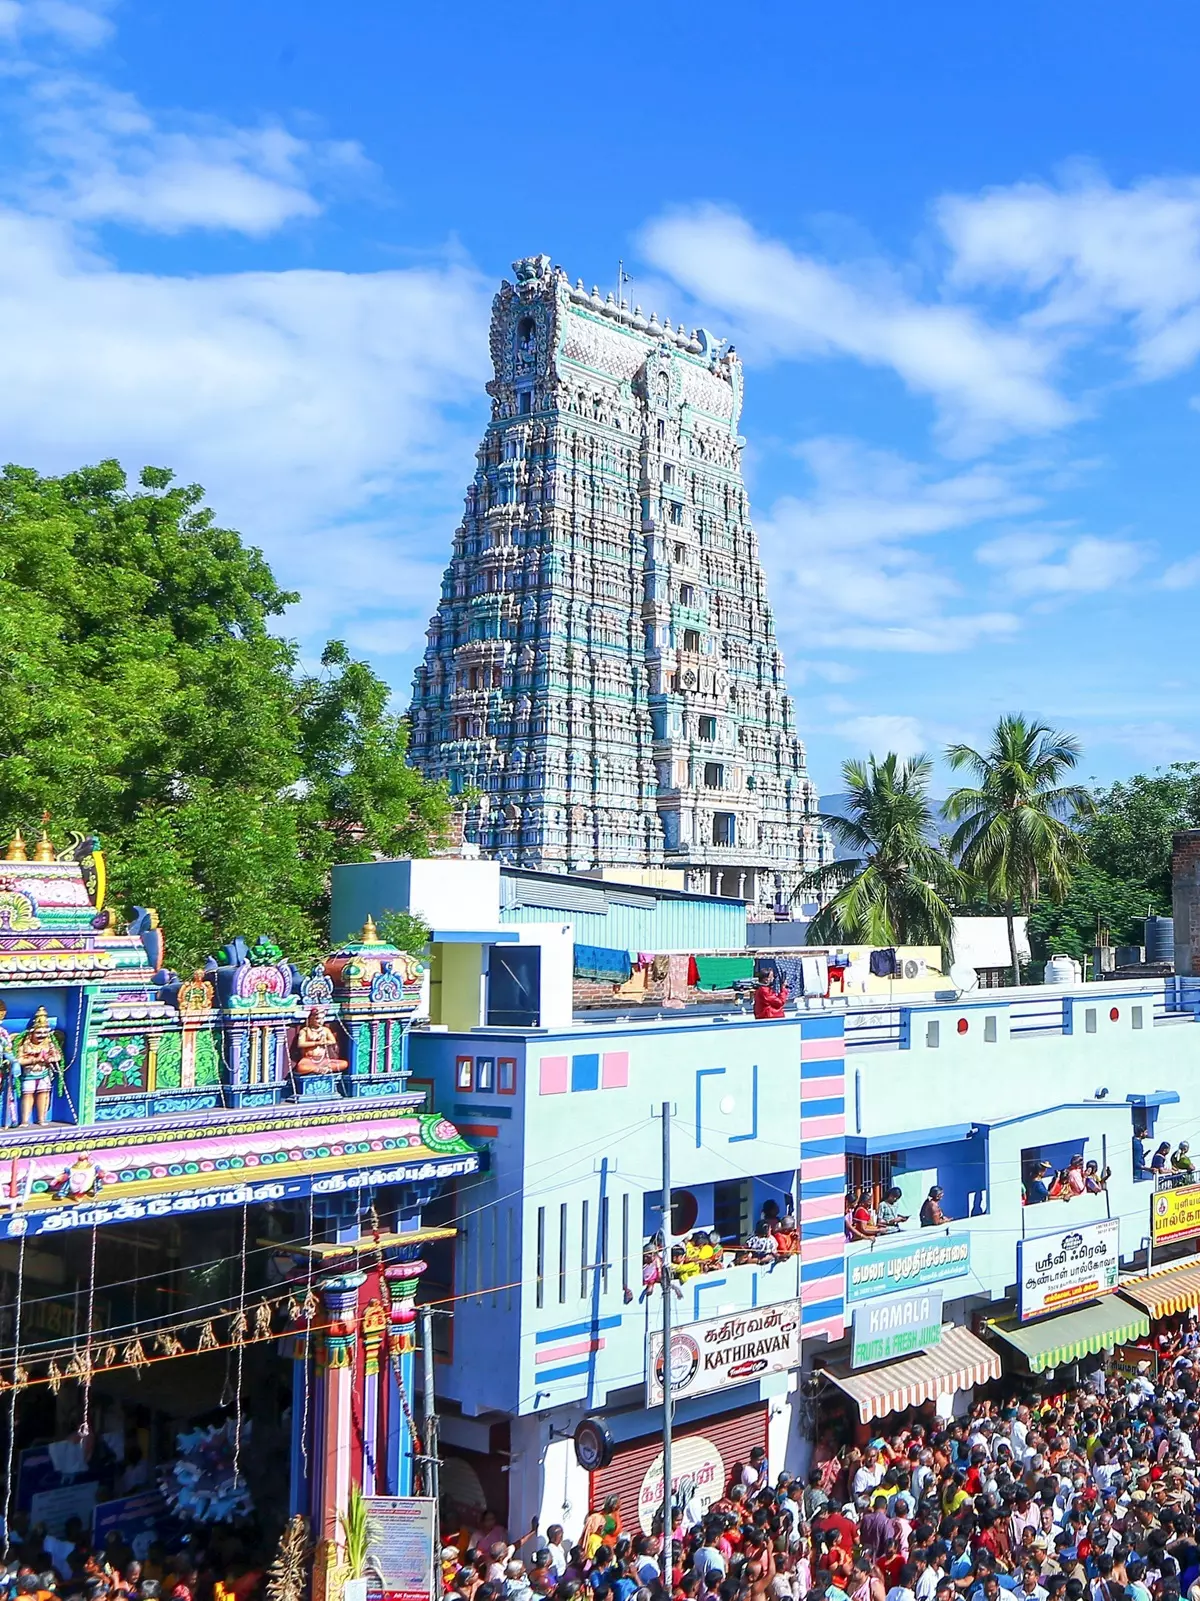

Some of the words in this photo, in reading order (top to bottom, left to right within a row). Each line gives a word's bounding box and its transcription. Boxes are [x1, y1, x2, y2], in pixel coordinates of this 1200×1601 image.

[35, 1183, 286, 1236] திருக்கோயில்
[852, 1261, 886, 1285] கமலா
[888, 1243, 968, 1283] பழமுதிர்ச்சோலை
[1070, 1240, 1107, 1260] ஃபிரஷ்
[1025, 1267, 1068, 1290] ஆண்டாள்
[1070, 1257, 1116, 1276] பால்கோவா
[704, 1309, 784, 1345] கதிரவன்
[870, 1297, 930, 1333] KAMALA
[703, 1333, 791, 1371] KATHIRAVAN
[856, 1337, 883, 1362] FRUITS
[885, 1336, 891, 1356] &
[892, 1329, 918, 1354] FRESH
[919, 1323, 941, 1348] JUICE
